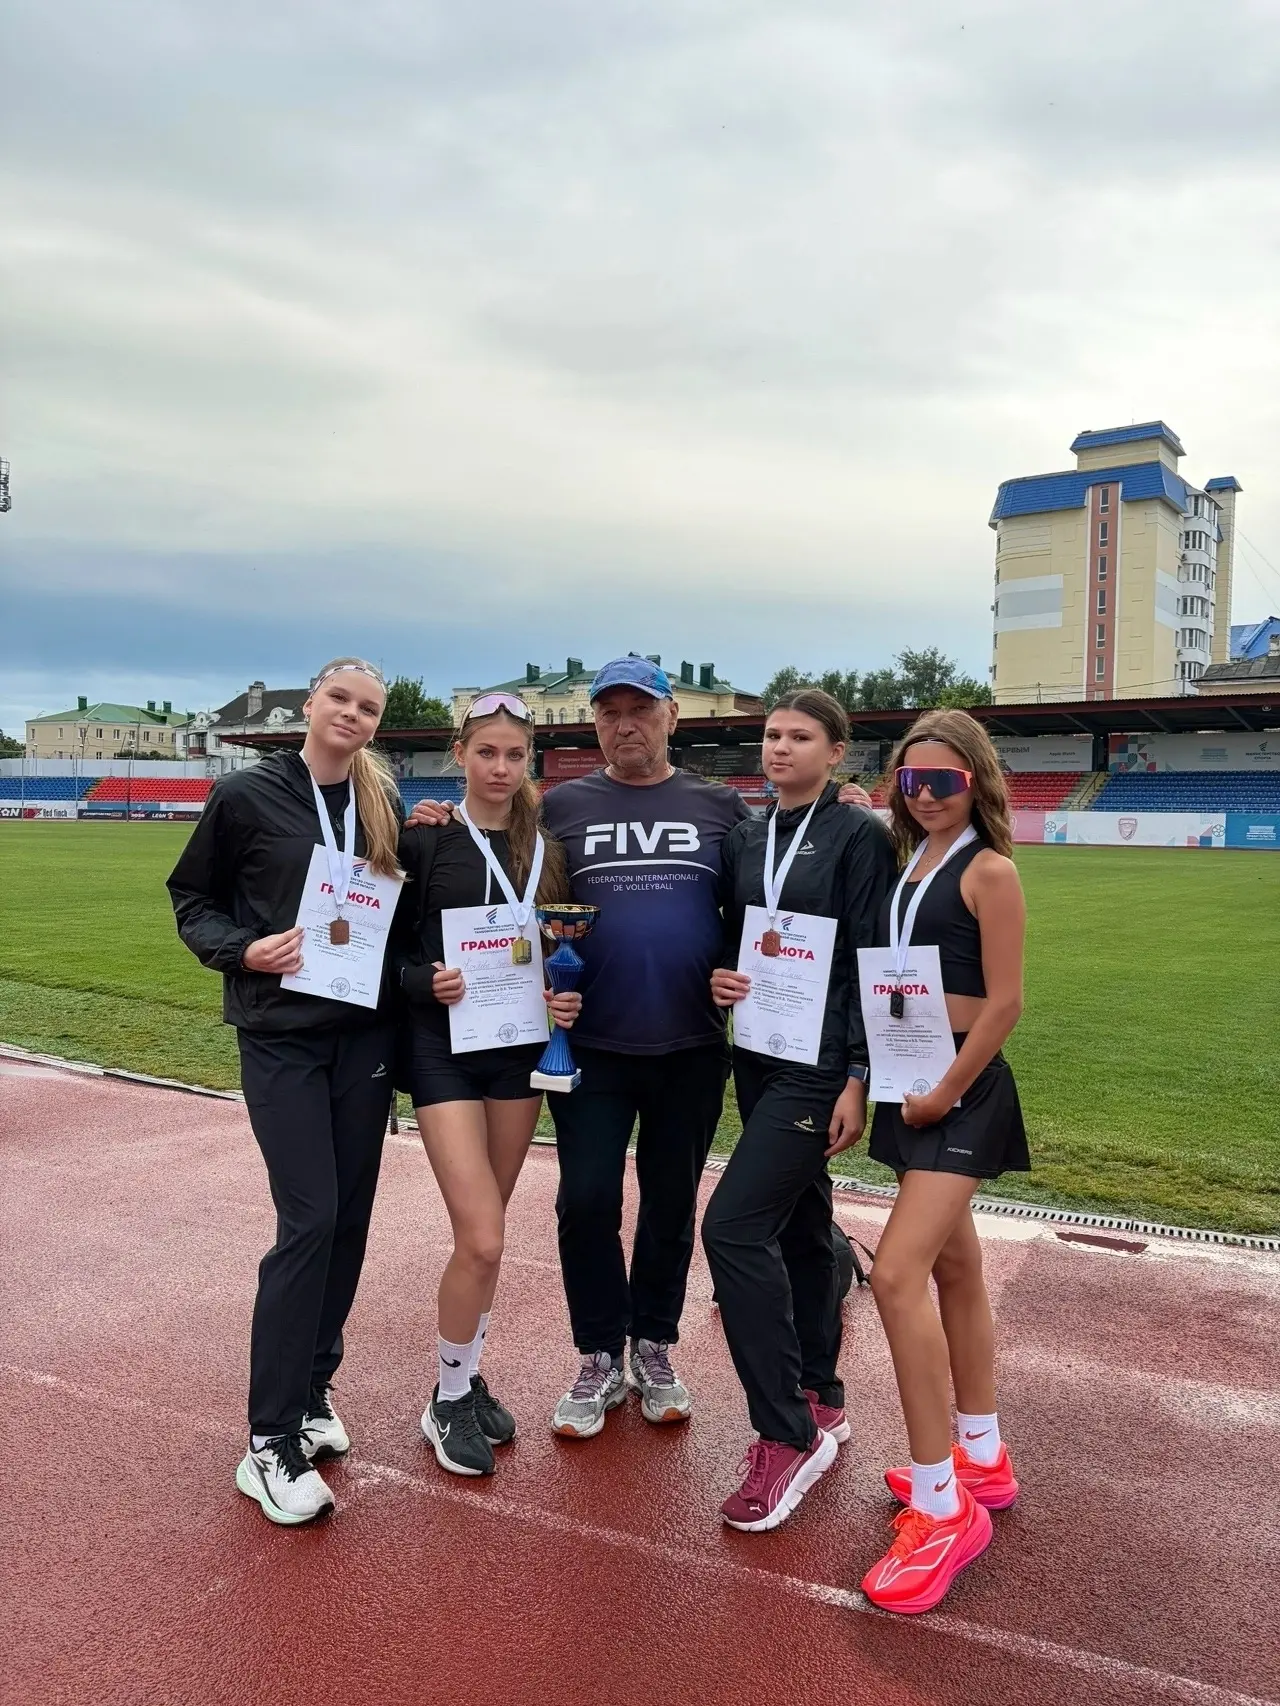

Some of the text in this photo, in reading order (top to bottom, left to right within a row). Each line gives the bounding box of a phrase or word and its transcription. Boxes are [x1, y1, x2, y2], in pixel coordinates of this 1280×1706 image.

[43, 809, 53, 817] Red
[584, 821, 701, 856] FIVB
[587, 873, 700, 884] FÉDÉRATION INTERNATIONALE
[613, 882, 674, 892] DE VOLLEYBALL
[320, 882, 381, 910] ГРМОТА
[460, 936, 517, 952] ГРАМОТ
[754, 940, 815, 961] ГМОТА
